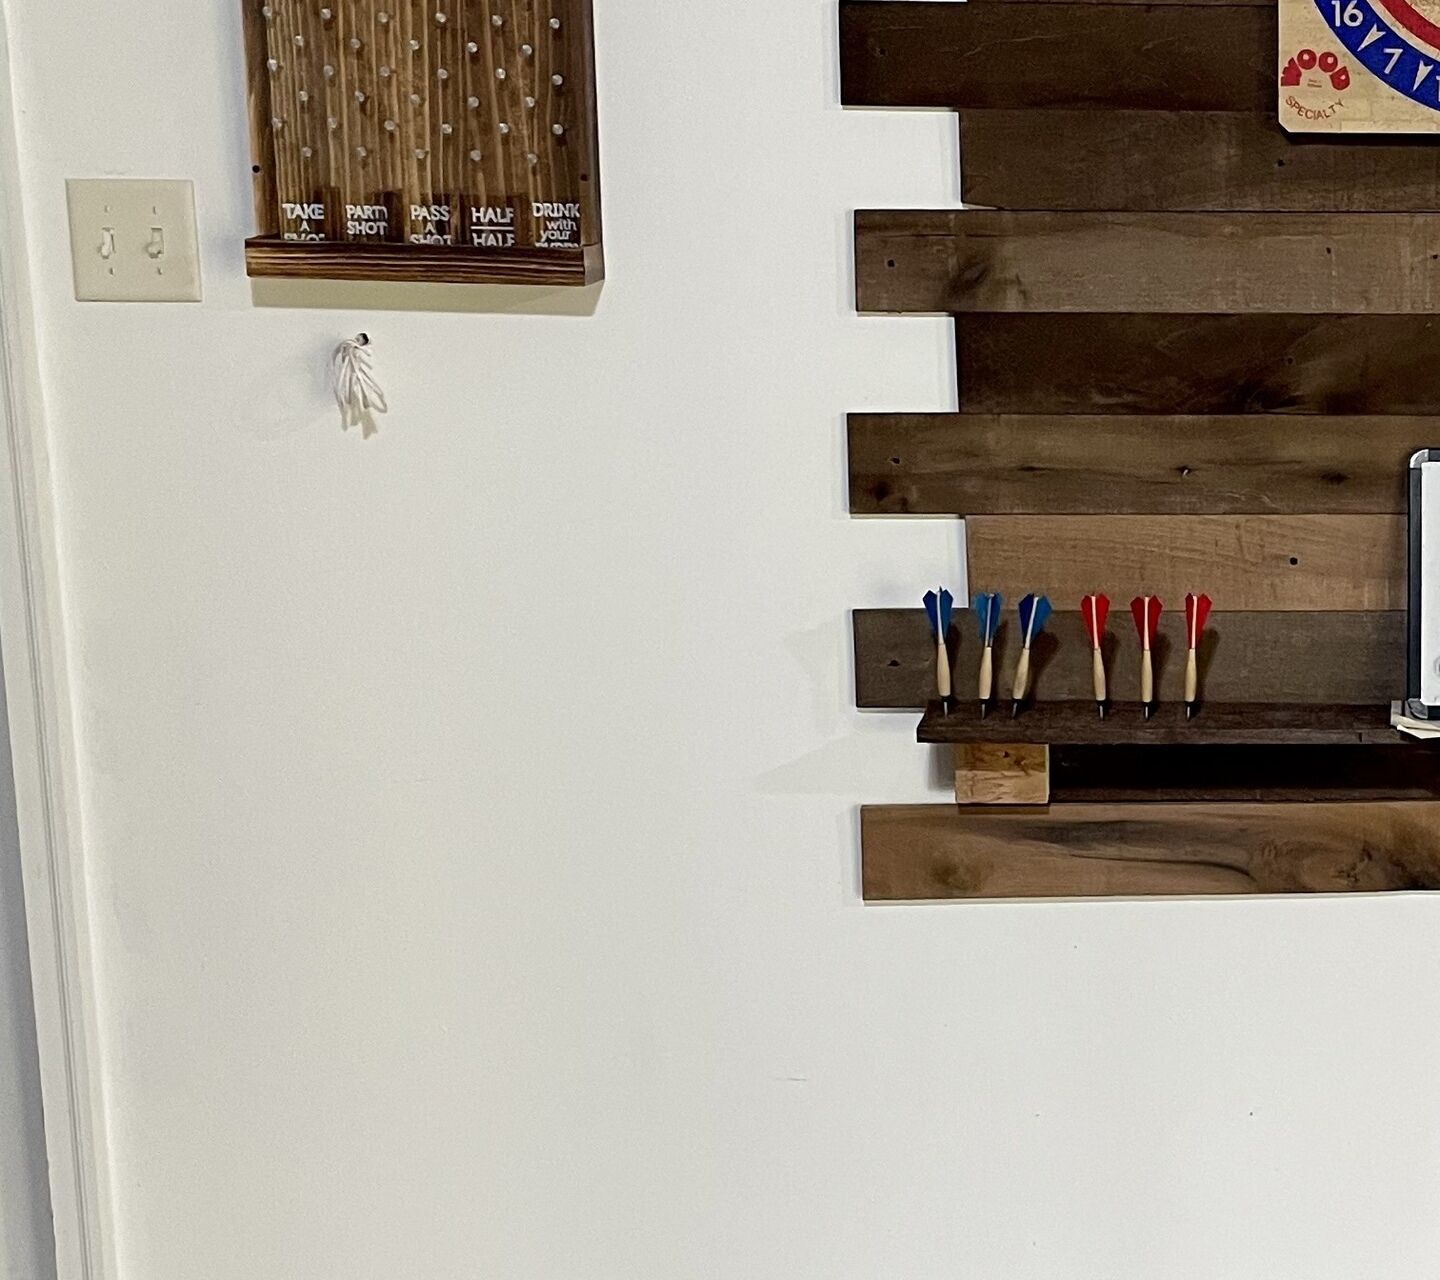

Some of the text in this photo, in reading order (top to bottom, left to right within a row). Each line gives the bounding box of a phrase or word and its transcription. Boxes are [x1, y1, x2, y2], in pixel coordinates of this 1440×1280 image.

[1331, 0, 1364, 27] 16
[1383, 48, 1404, 75] 7
[1285, 95, 1344, 121] SPECIALTY
[282, 203, 325, 220] TAKE
[410, 204, 450, 221] PASS
[471, 207, 514, 223] HALF
[532, 202, 580, 218] DRINK
[300, 220, 311, 232] A
[346, 221, 388, 236] SHOT
[425, 222, 437, 234] A
[545, 218, 577, 231] with
[472, 233, 515, 247] HALF
[540, 230, 571, 242] your
